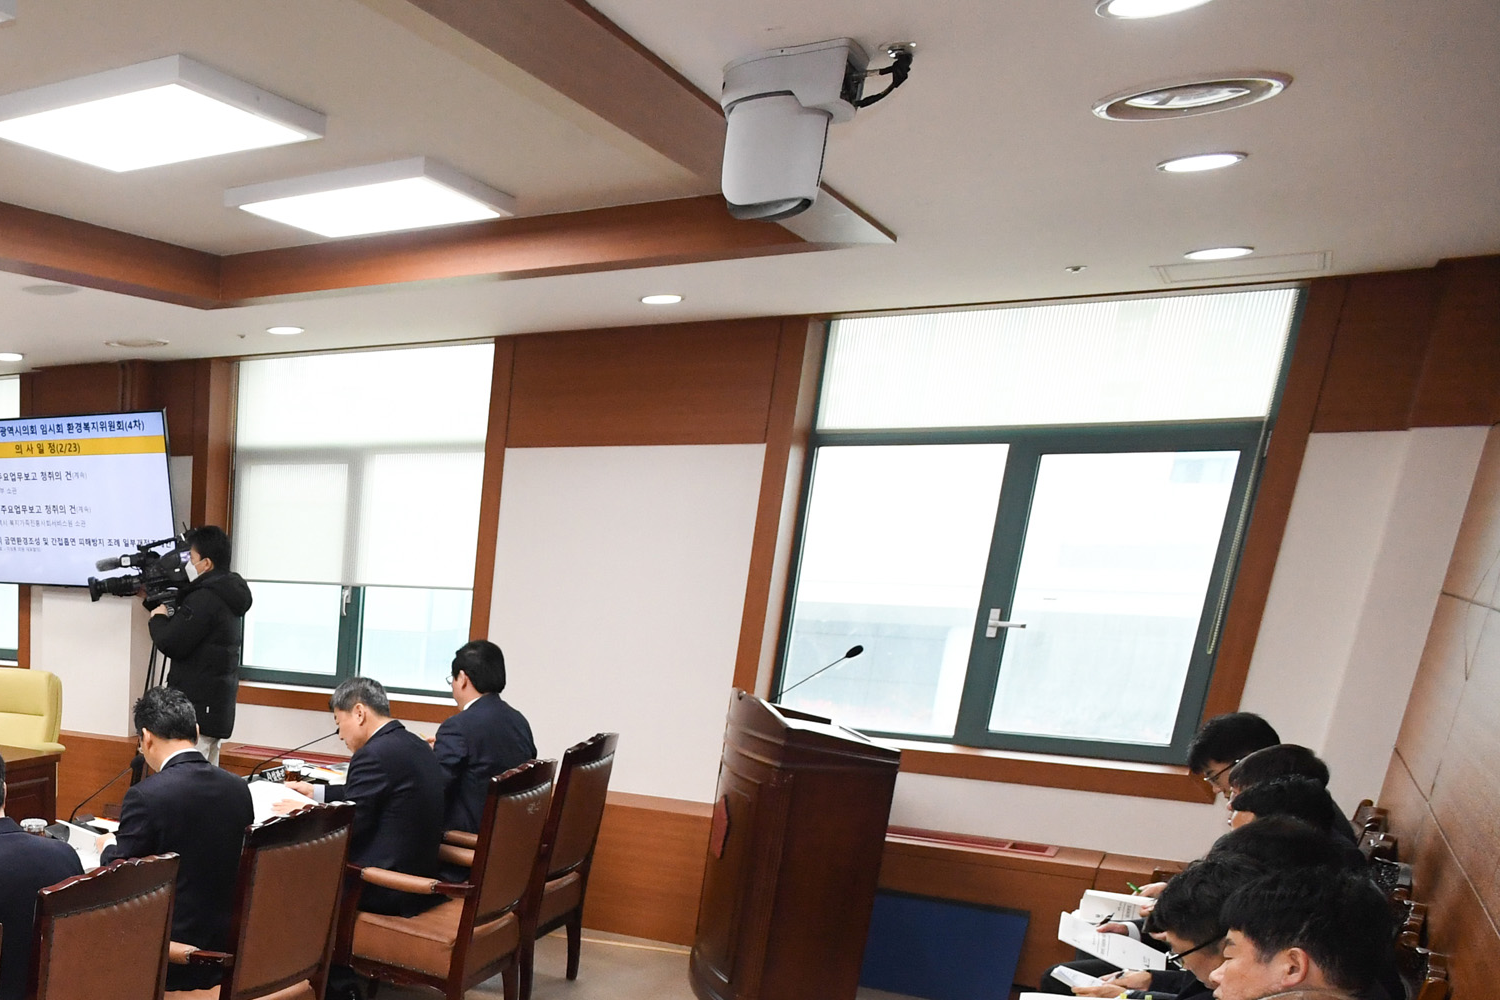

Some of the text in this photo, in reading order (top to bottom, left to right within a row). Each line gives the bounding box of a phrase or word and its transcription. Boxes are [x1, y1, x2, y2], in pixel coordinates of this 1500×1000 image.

[40, 423, 64, 436] 임시회
[66, 418, 145, 434] 환경복지위원회(4차)
[40, 470, 62, 482] 청취의
[6, 487, 17, 496] 소관
[0, 504, 42, 515] 주요업무보고
[44, 504, 67, 515] 청취의
[75, 519, 86, 528] 소관
[4, 536, 41, 547] 금연환경조성
[43, 536, 49, 546] 및
[51, 537, 77, 547] 간접흡연
[78, 537, 105, 548] 피해방지
[107, 538, 121, 548] 조례
